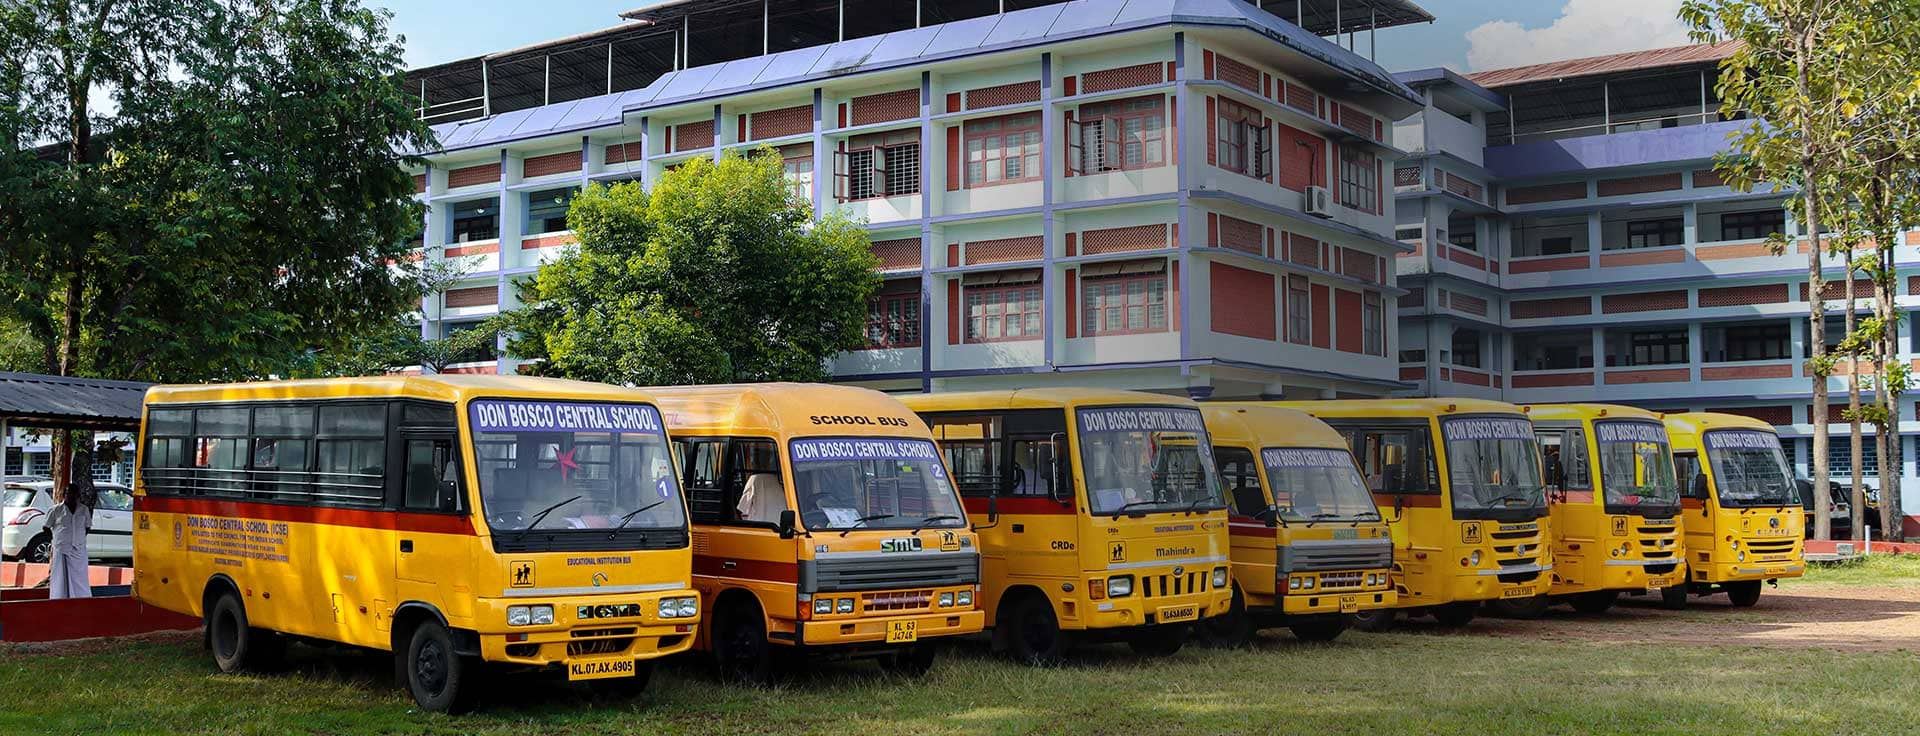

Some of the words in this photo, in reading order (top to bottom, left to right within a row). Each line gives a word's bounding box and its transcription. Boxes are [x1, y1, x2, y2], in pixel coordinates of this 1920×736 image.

[477, 404, 508, 427] DON
[509, 404, 554, 428] BOSCO
[556, 405, 613, 428] CENTRAL
[612, 407, 658, 431] SCHOOL
[810, 415, 875, 426] SCHOOL
[877, 416, 909, 427] BUS
[1083, 412, 1107, 431] DON
[1106, 411, 1138, 431] BOSCO
[1138, 410, 1176, 431] CENTRAL
[1174, 411, 1203, 431] SCHOOL
[1445, 422, 1467, 440] DON
[1466, 421, 1492, 439] BOSCO
[1491, 421, 1520, 439] CENTRAL
[1615, 424, 1637, 441] BOSCO
[795, 443, 819, 459] DON
[820, 443, 854, 458] BOSCO
[855, 442, 898, 458] CENTRAL
[899, 443, 934, 459] SCHOOL
[932, 463, 943, 477] 2
[659, 480, 668, 497] 1
[187, 516, 199, 527] DON
[200, 517, 218, 529] BOSCO
[220, 518, 245, 531] CENTRAL
[246, 520, 269, 534] SCHOOL
[271, 523, 288, 538] (ICSE)
[880, 538, 922, 552] SML
[1051, 541, 1075, 550] CRDe
[1155, 546, 1195, 557] Mahindra
[567, 557, 595, 566] EDUCATIONAL
[597, 556, 622, 565] INSTITUTION
[894, 622, 903, 631] KL
[906, 621, 915, 631] 63
[892, 631, 914, 641] J4746
[571, 660, 633, 676] KL.07.AX.4905
